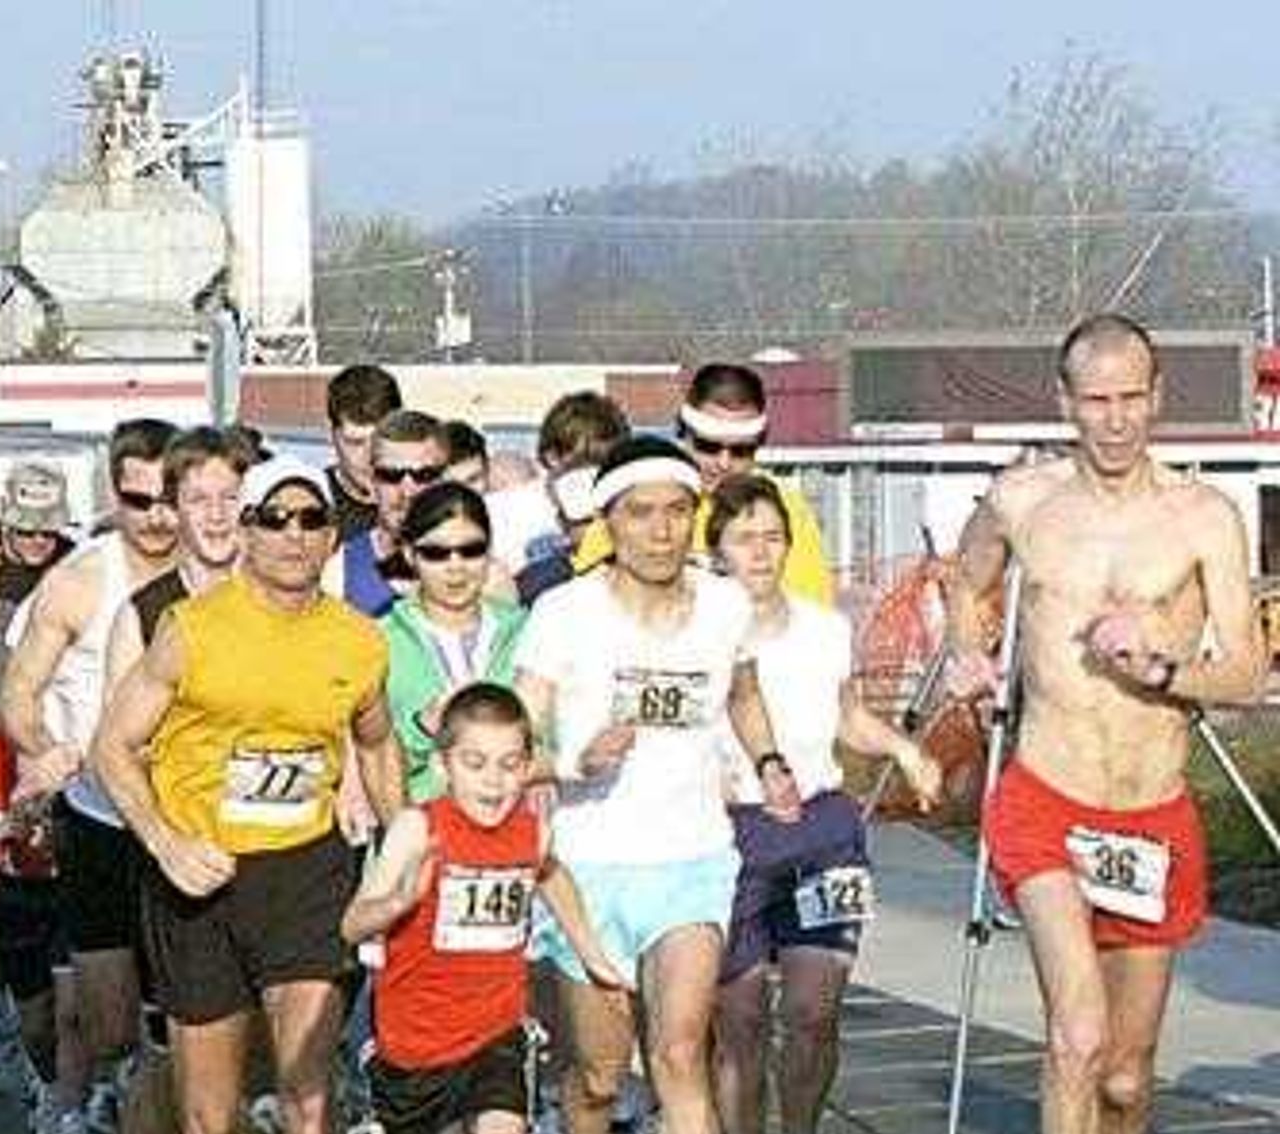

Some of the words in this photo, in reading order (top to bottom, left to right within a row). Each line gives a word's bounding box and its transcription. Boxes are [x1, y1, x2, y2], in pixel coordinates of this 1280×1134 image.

[640, 687, 683, 721] 69
[1096, 844, 1136, 890] 36
[816, 876, 862, 914] 122
